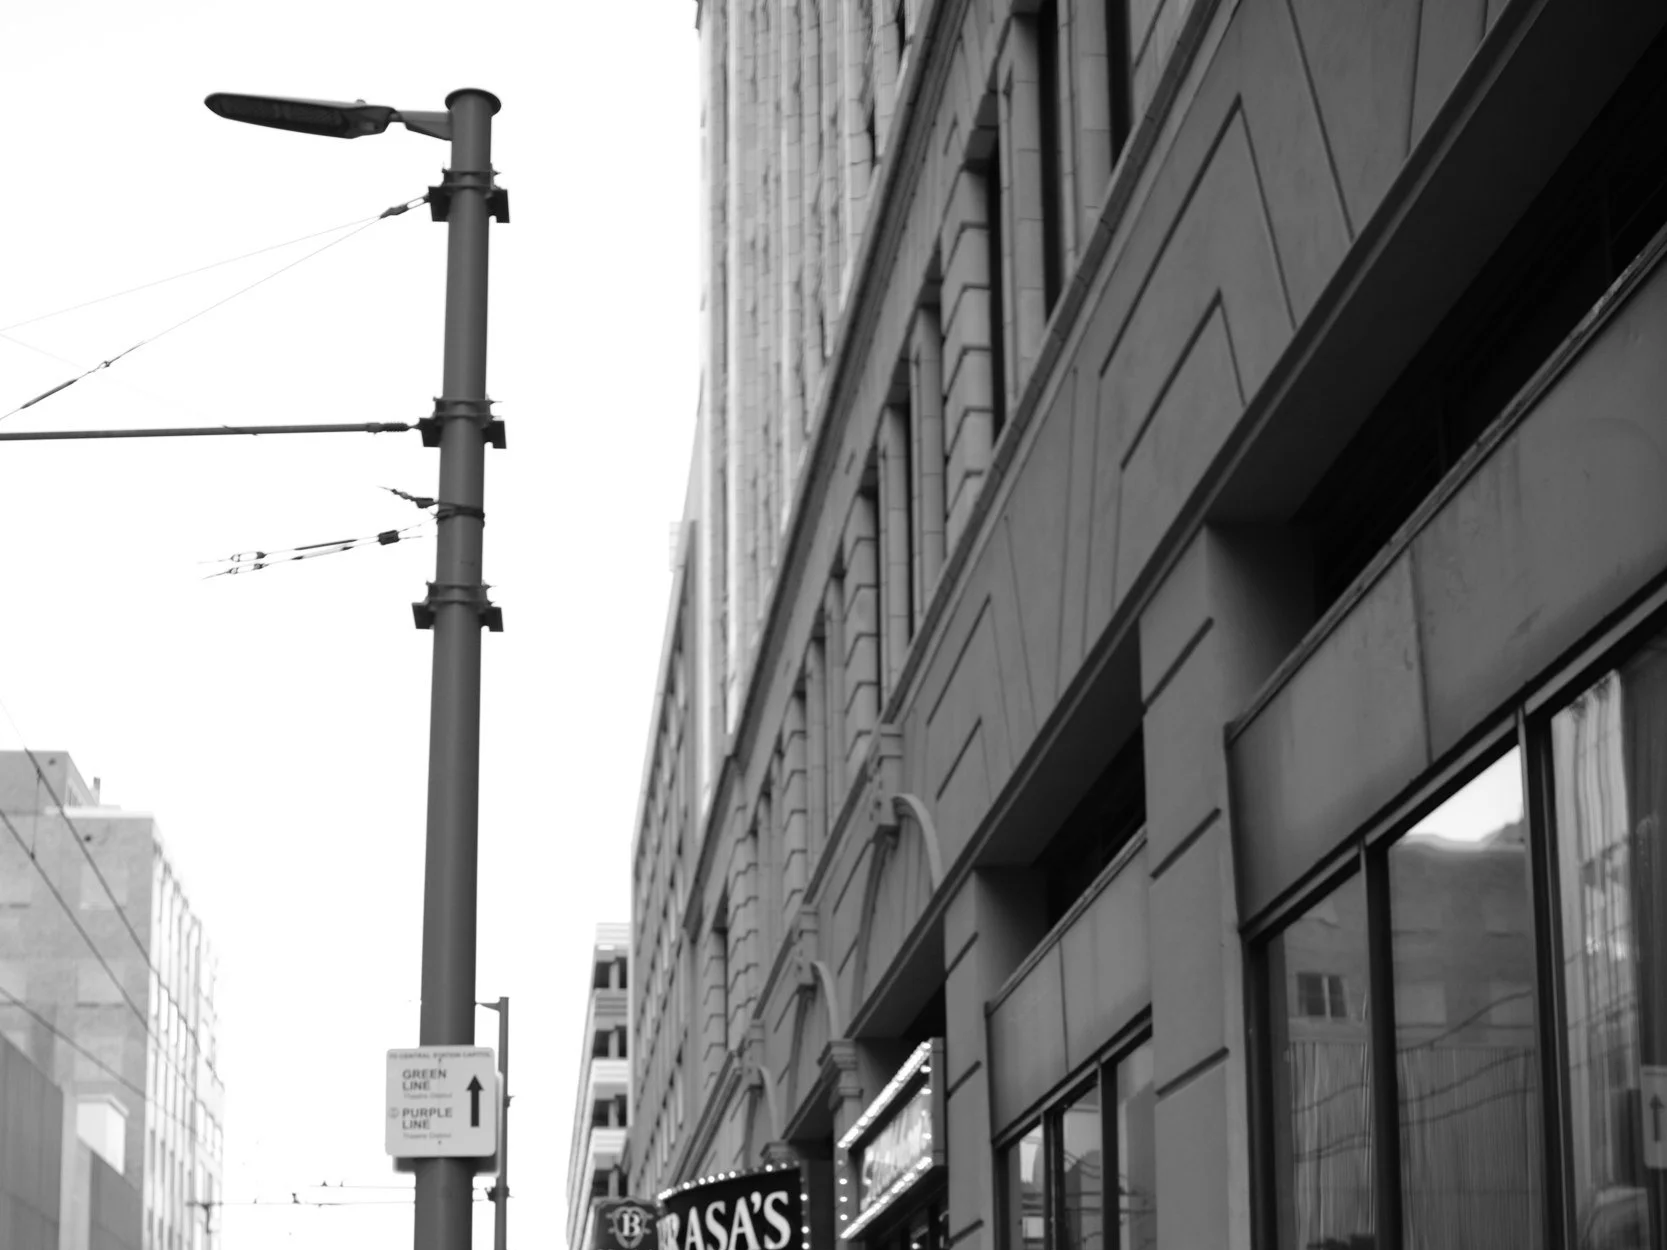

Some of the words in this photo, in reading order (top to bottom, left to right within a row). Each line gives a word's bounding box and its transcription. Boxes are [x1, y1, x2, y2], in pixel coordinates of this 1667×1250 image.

[402, 1069, 447, 1079] GREEN
[402, 1081, 430, 1091] LINE
[402, 1107, 453, 1118] PURPLE
[402, 1119, 430, 1130] LINE
[622, 1213, 641, 1235] B
